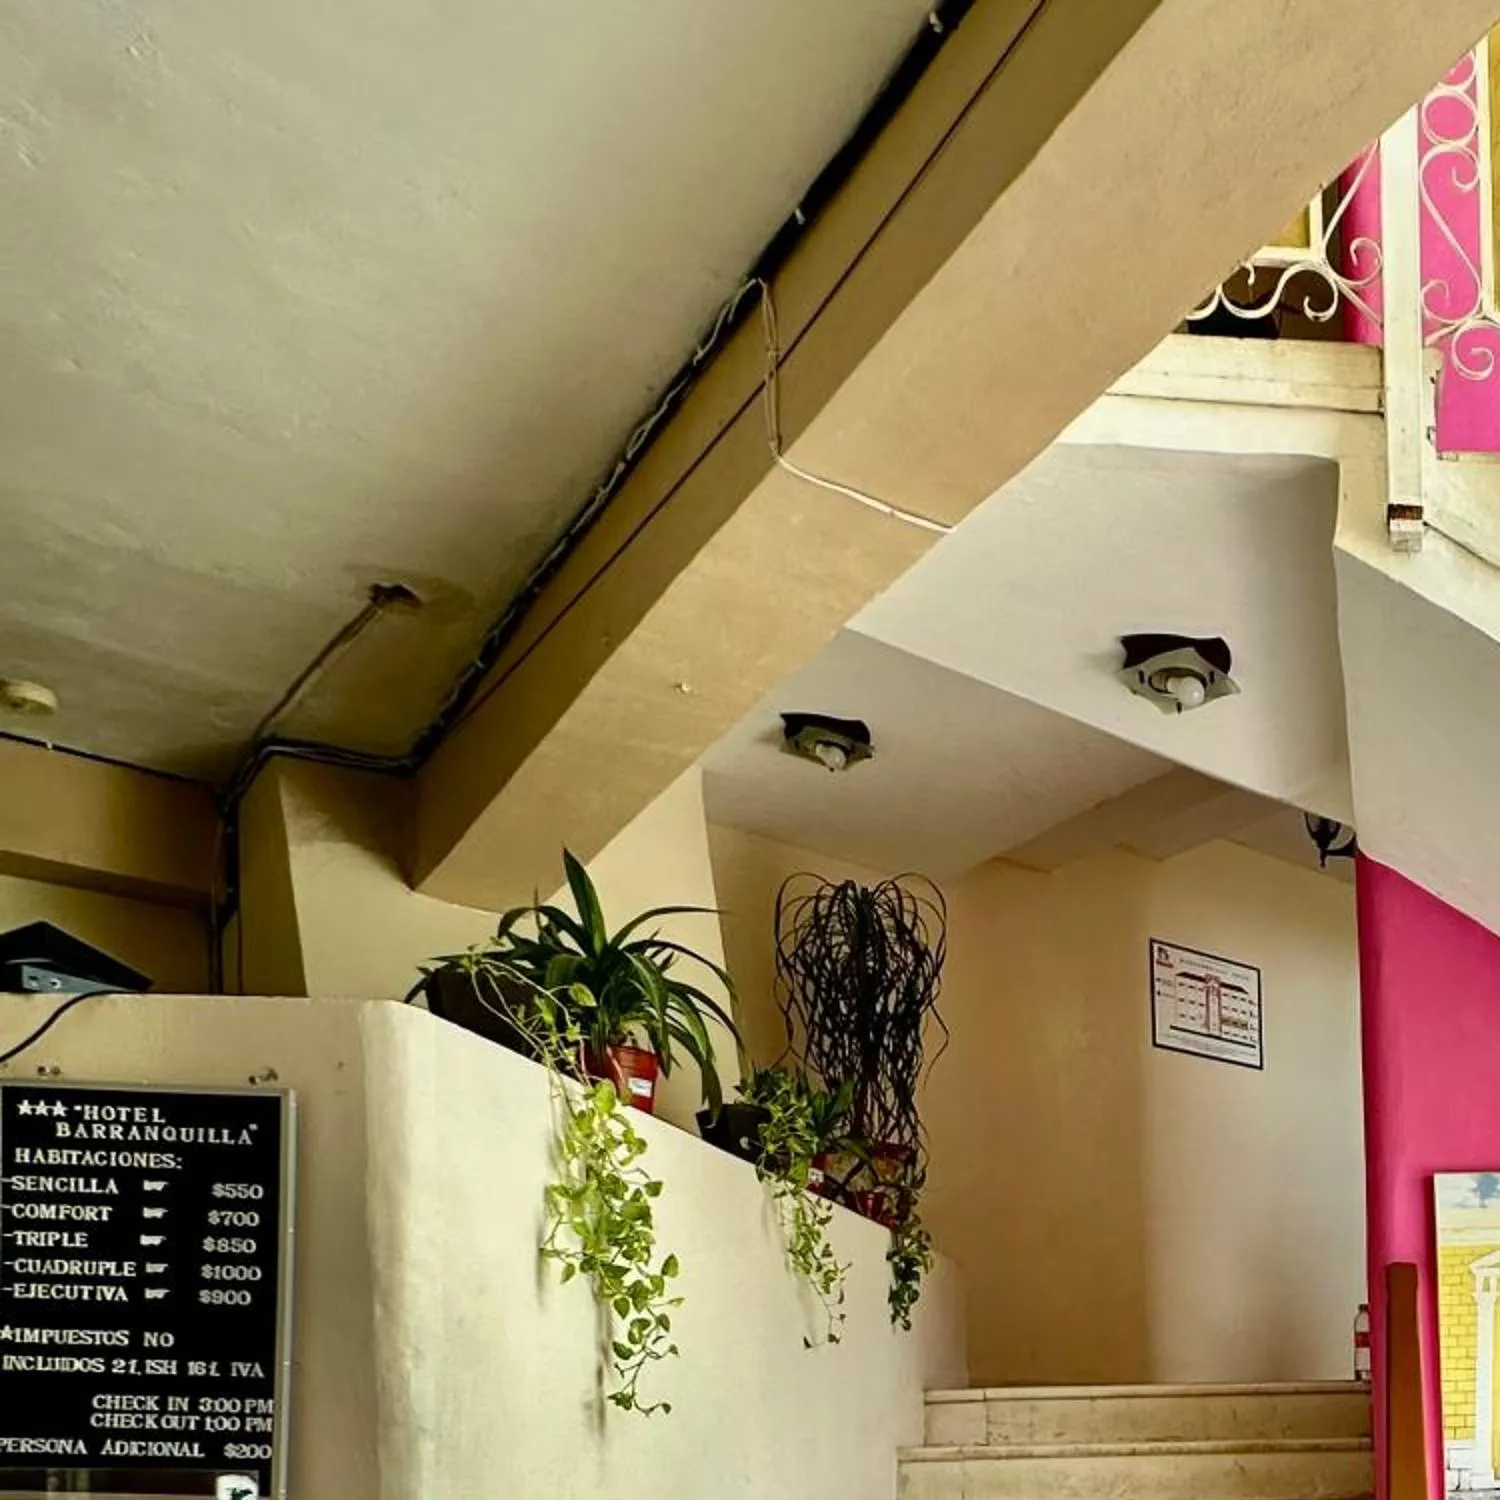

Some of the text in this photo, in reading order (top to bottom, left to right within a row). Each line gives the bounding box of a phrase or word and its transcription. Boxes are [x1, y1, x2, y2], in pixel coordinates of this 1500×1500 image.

[14, 1147, 183, 1170] HABITACIONES:
[211, 1183, 264, 1200] $550
[207, 1209, 260, 1227] $700
[202, 1236, 257, 1254] $850
[201, 1263, 262, 1281] $1000
[199, 1289, 252, 1306] $900
[143, 1331, 175, 1348] NO
[2, 1354, 106, 1373] INCLUIDOS
[231, 1361, 265, 1378] IVA
[91, 1393, 160, 1411] CHECK
[167, 1395, 190, 1412] IN
[244, 1398, 274, 1414] PM
[244, 1416, 273, 1433] PM
[100, 1438, 206, 1458] ADICIONAL
[223, 1442, 274, 1460] $200
